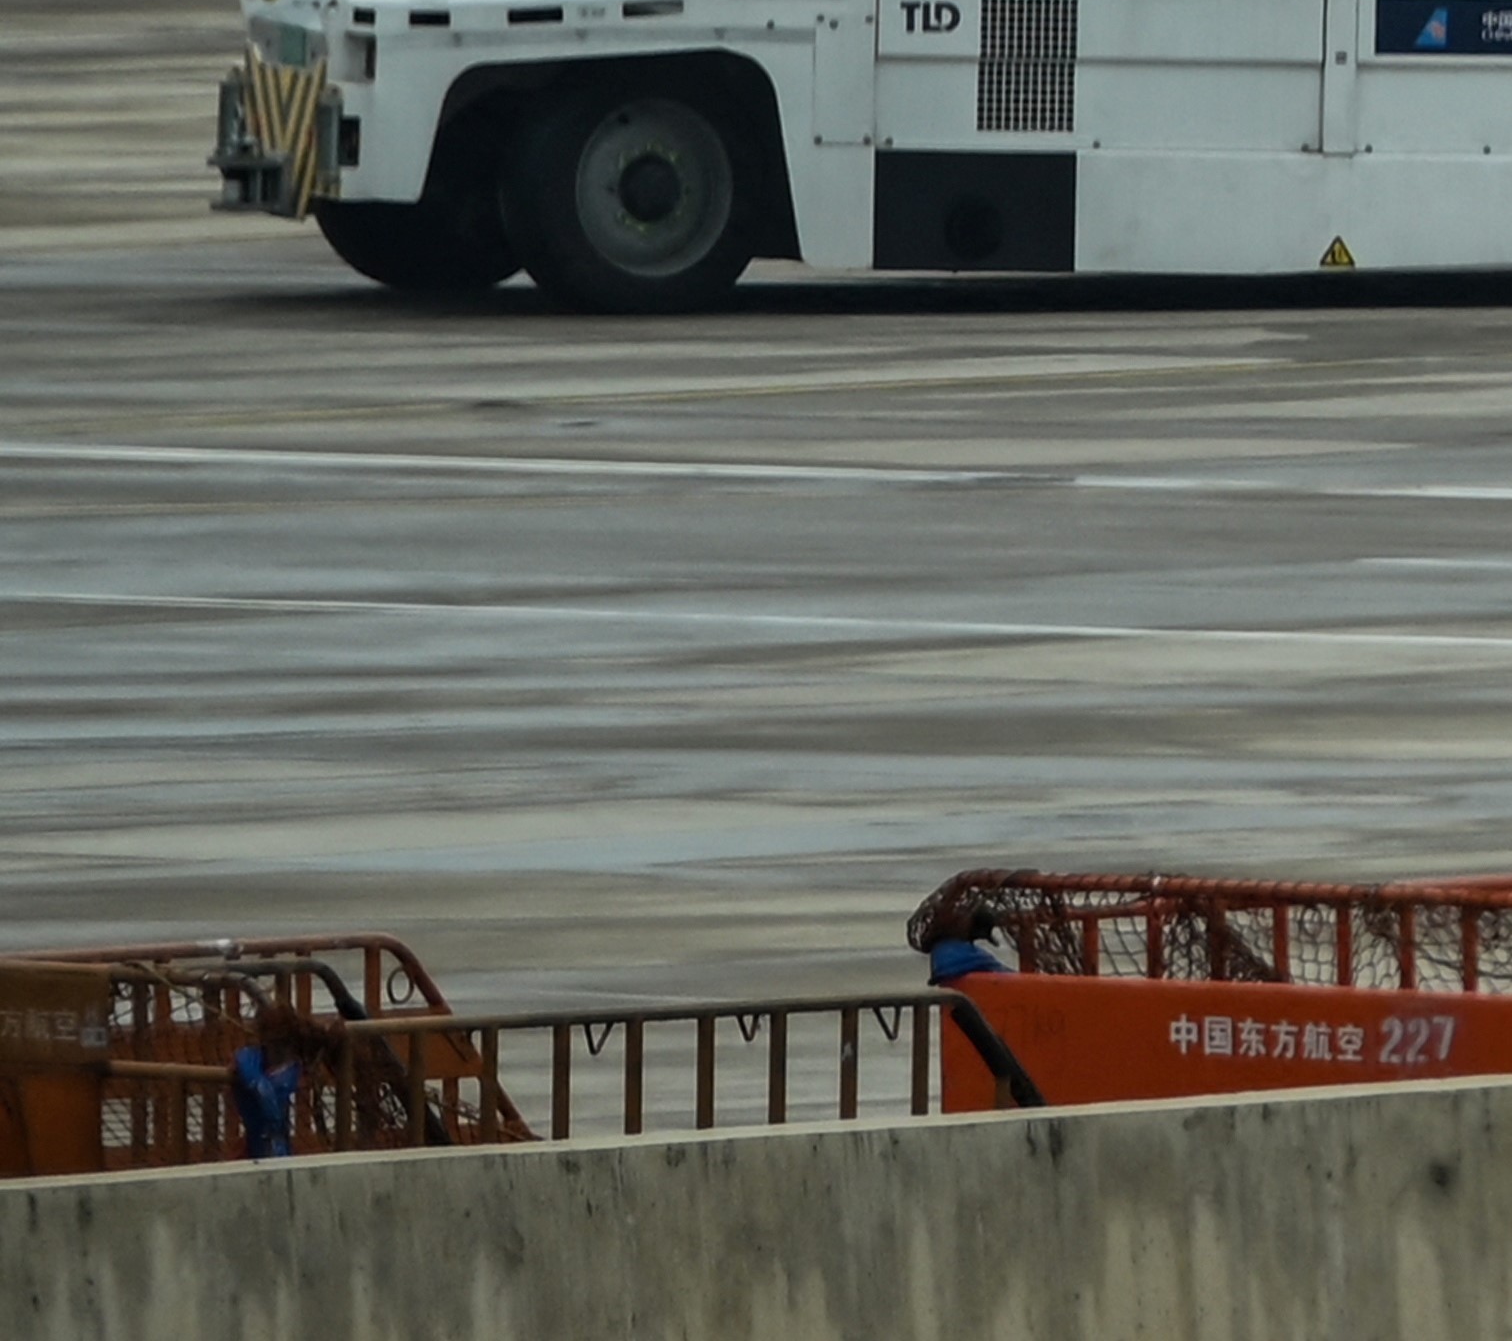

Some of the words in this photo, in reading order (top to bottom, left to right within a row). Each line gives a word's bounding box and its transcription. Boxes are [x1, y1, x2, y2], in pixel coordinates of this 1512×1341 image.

[899, 0, 961, 34] TLD
[1169, 1013, 1365, 1062] 中国东方航空
[1379, 1015, 1456, 1064] 227
